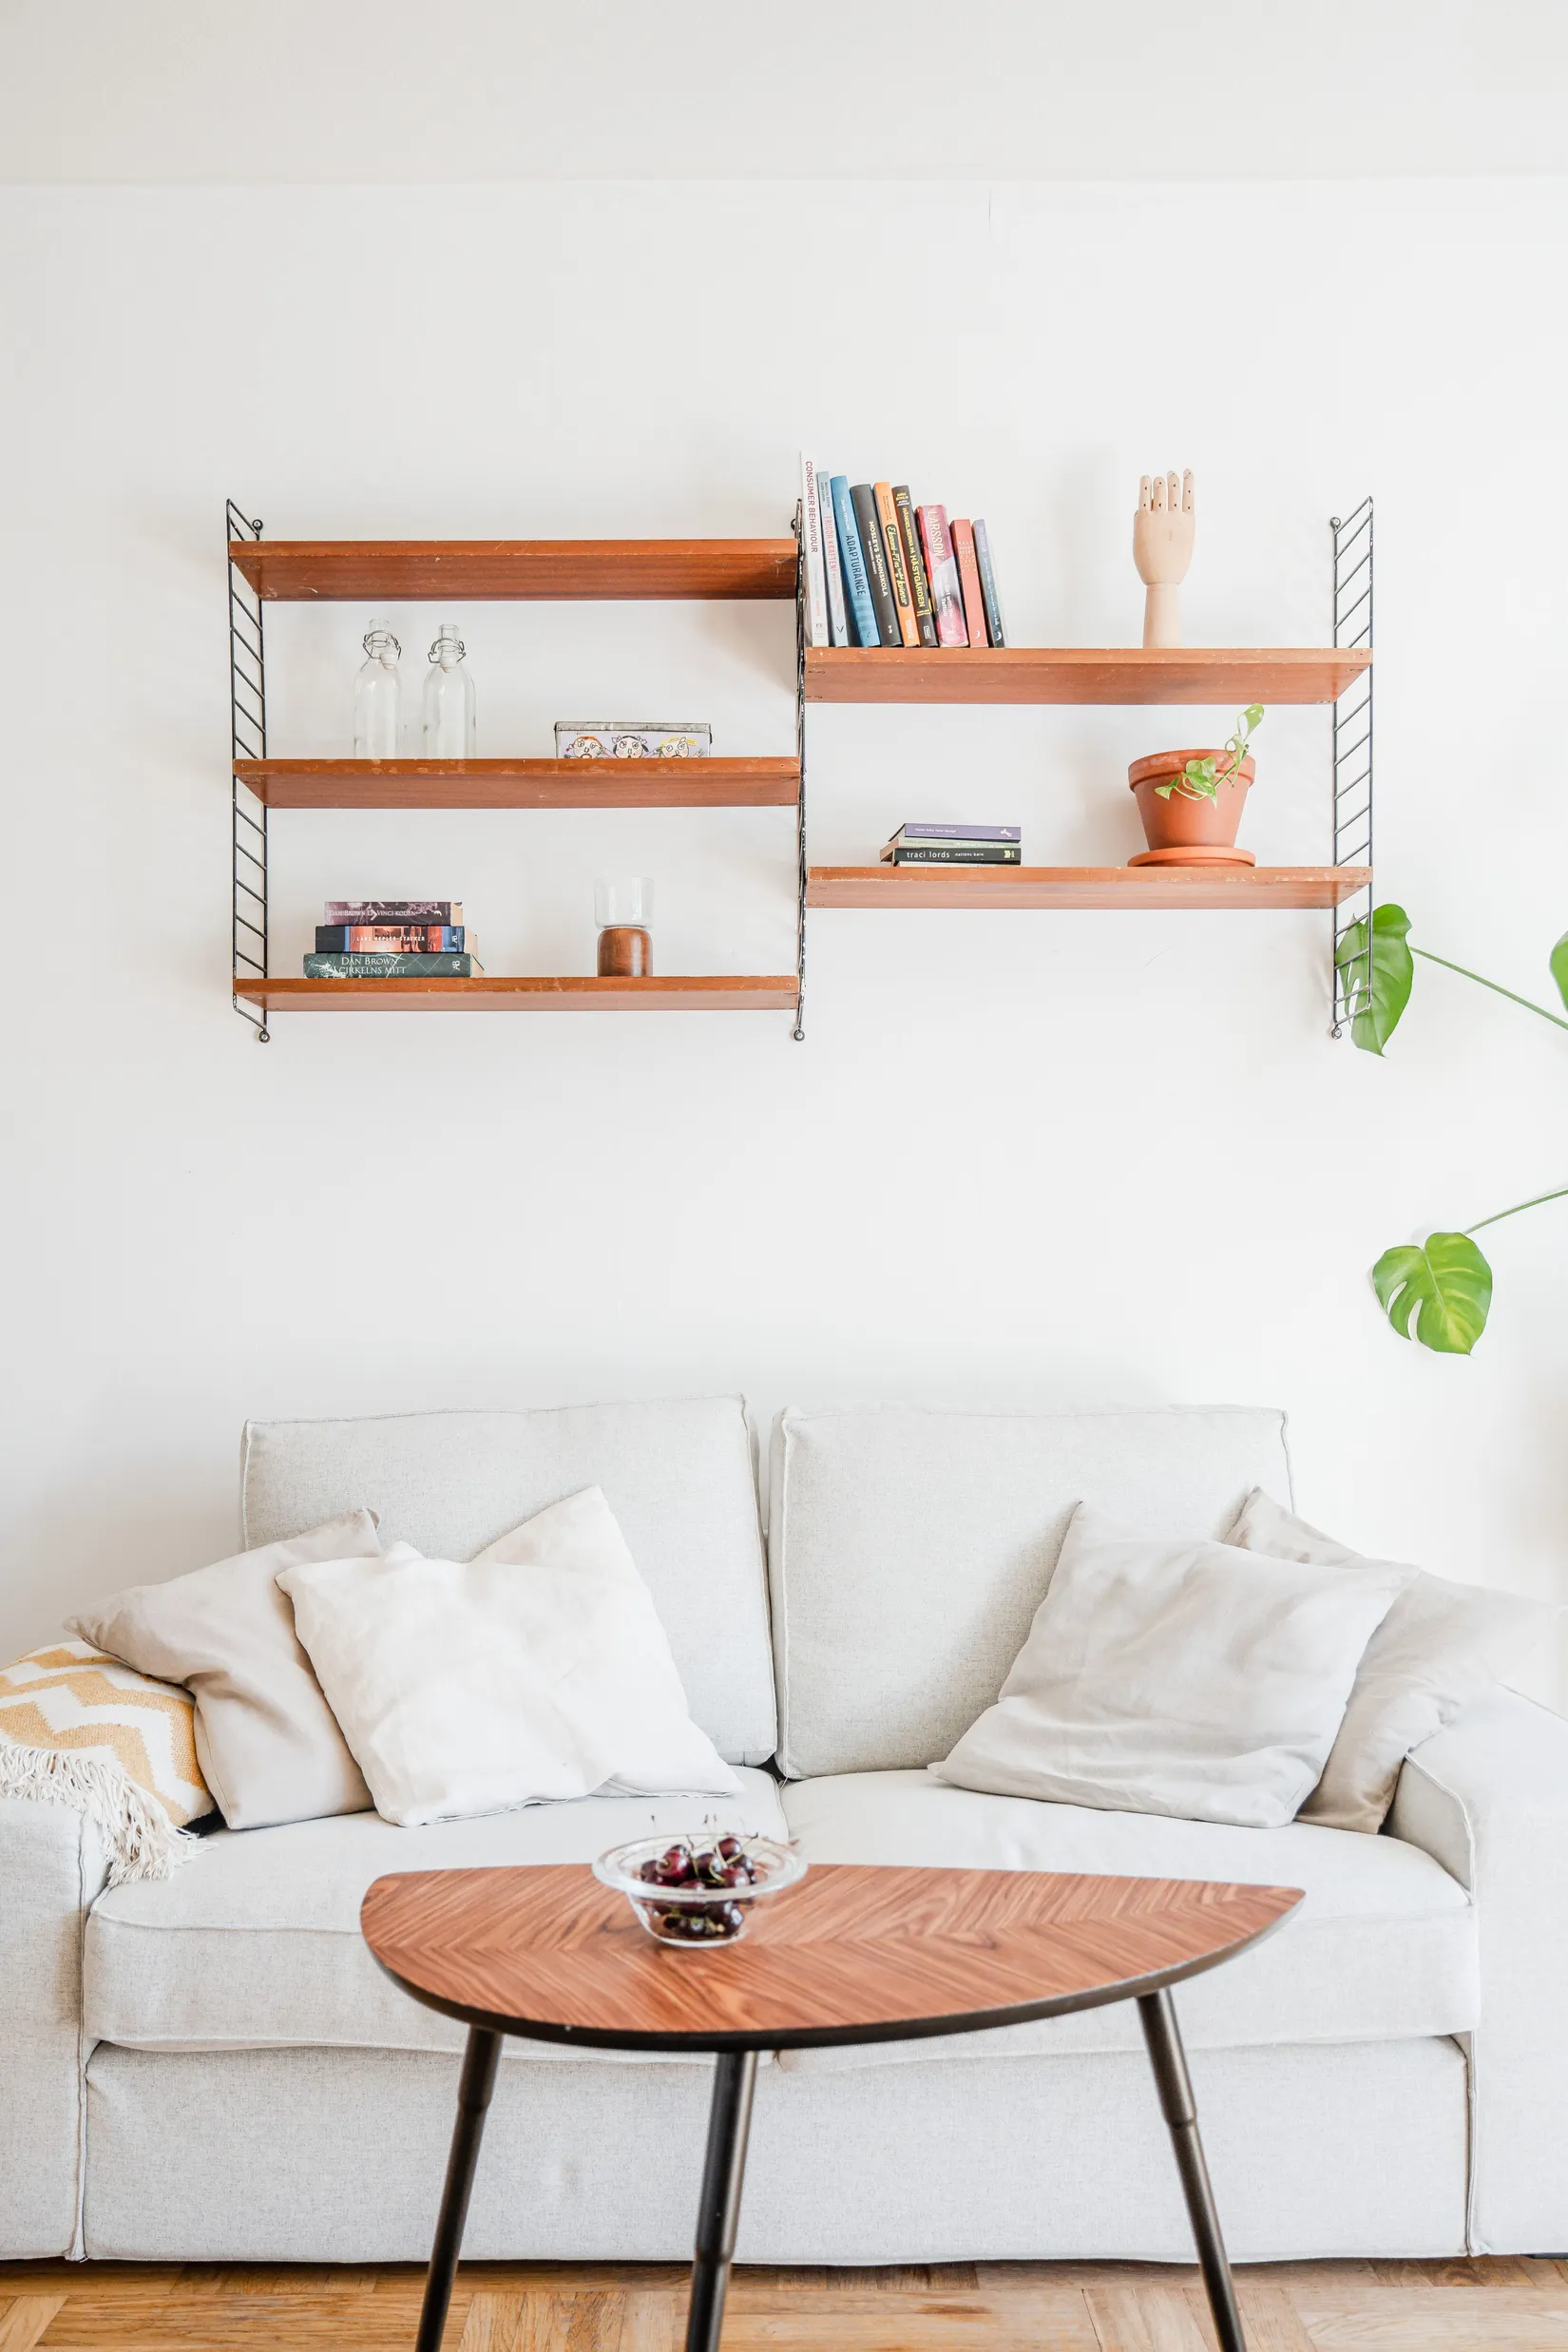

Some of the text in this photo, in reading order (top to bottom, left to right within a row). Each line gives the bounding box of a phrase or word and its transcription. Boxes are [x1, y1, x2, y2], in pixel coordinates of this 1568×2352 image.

[805, 461, 818, 553] CONSUMER BEHAVIOUR
[927, 510, 946, 557] LARSSON
[846, 535, 867, 596] ADAPTURANCE
[868, 521, 889, 597] MOSLEYS SÖMNSKOLA
[909, 555, 926, 607] HÄSTGÅRDEN
[928, 851, 950, 859] lords
[341, 956, 397, 966] DAN BROWN
[385, 966, 407, 975] MITT
